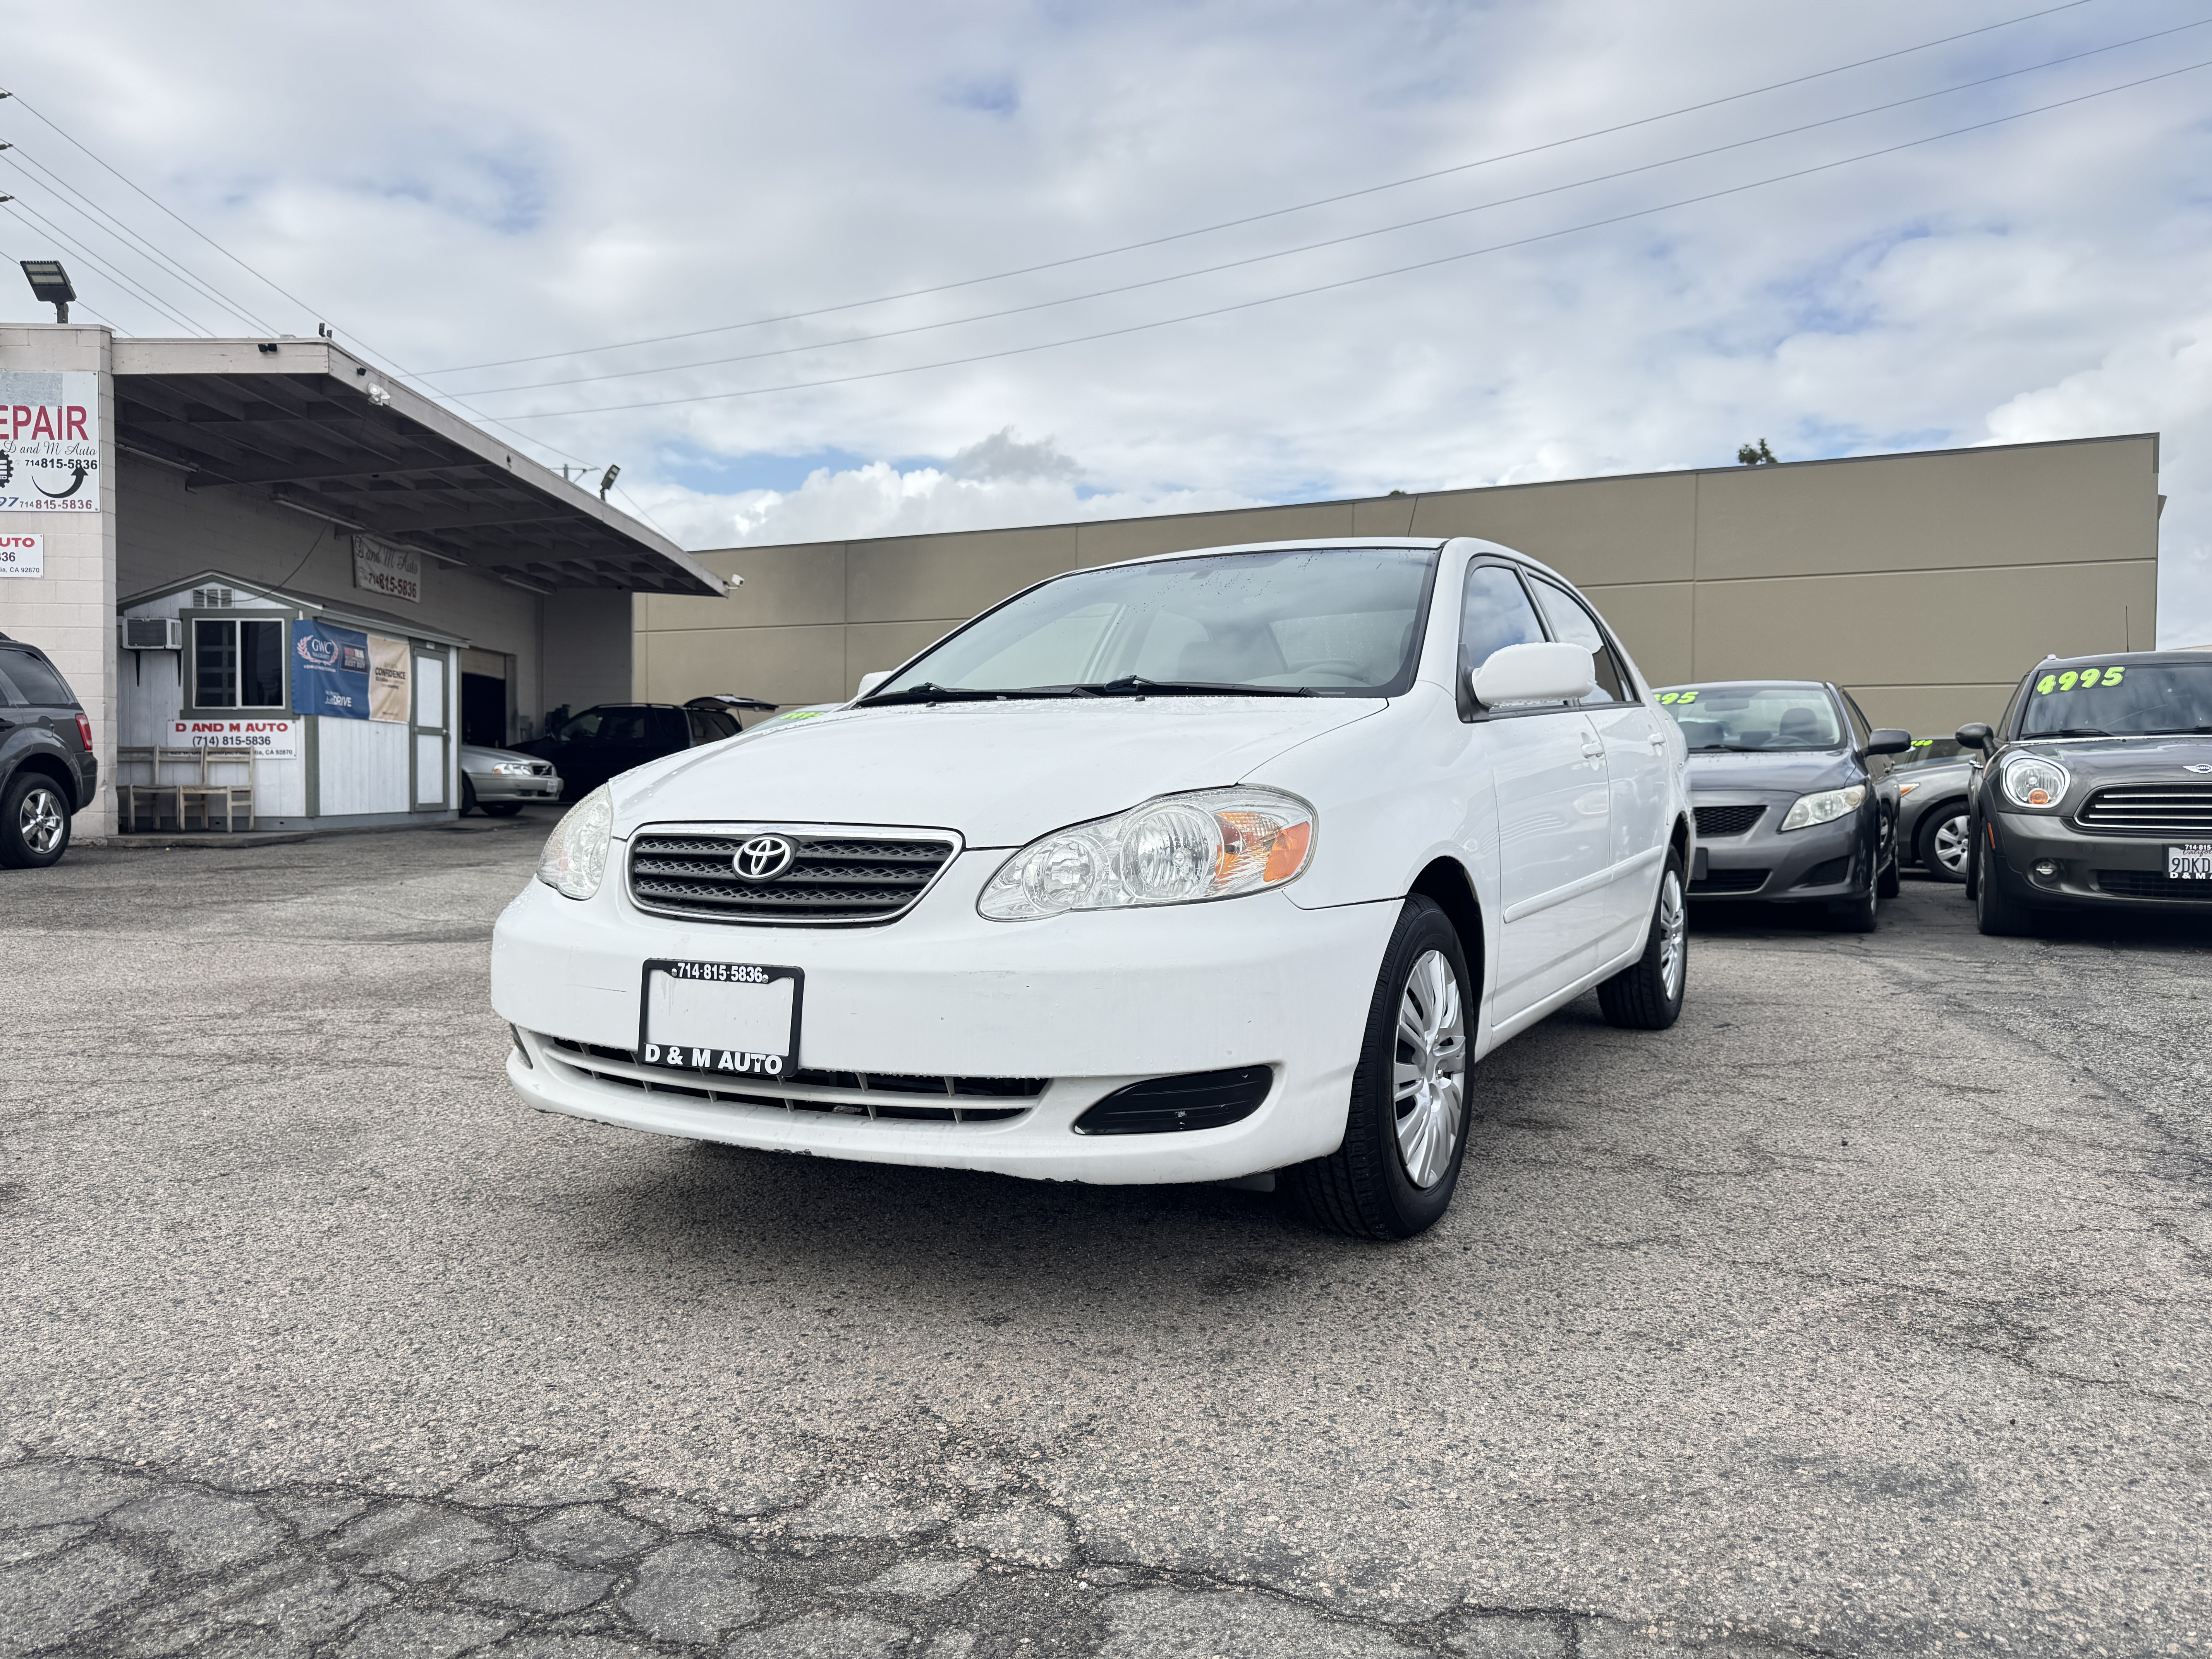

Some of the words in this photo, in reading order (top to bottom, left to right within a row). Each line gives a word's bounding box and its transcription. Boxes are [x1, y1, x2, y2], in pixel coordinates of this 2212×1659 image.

[4, 439, 16, 453] D
[20, 442, 40, 454] and
[44, 441, 61, 455] M
[65, 442, 97, 456] Auto
[366, 544, 381, 563] and
[312, 639, 332, 654] GWC
[375, 667, 406, 680] CONFIDENCE
[2037, 667, 2125, 695] 4995
[175, 723, 187, 732] D
[192, 723, 224, 732] AND
[229, 723, 240, 732] M
[246, 723, 288, 732] AUTO
[192, 736, 219, 747] (714)
[223, 736, 271, 745] 815-5836
[645, 1044, 660, 1062] D
[667, 1046, 683, 1065] &
[692, 1048, 711, 1068] M
[718, 1051, 783, 1075] AUTO
